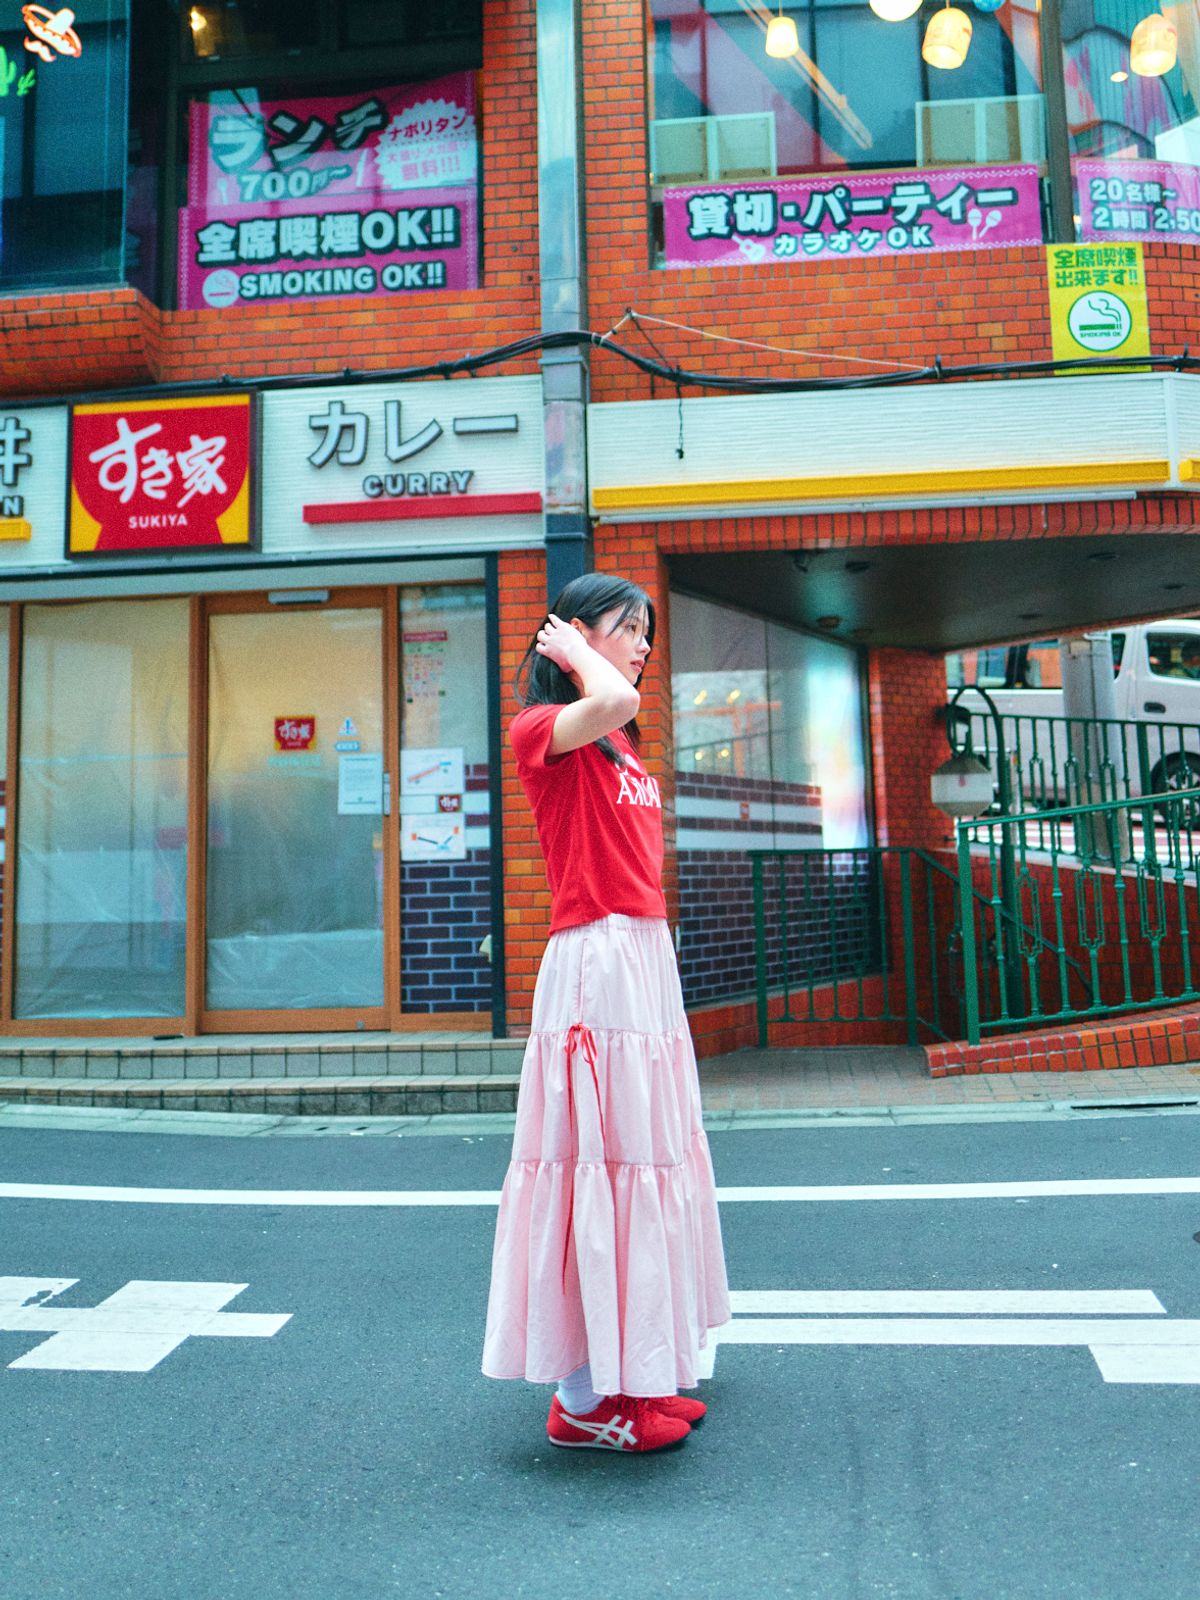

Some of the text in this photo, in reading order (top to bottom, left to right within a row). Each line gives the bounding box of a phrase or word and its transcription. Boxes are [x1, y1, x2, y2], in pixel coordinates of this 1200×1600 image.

[208, 98, 389, 173] ランチ
[387, 115, 467, 142] ナポリタン
[689, 183, 1017, 237] 貸切・パーティー
[196, 205, 458, 265] 全席喫煙OK!!
[773, 225, 934, 256] カラオケOK
[1054, 247, 1137, 269] 全席喫煙
[239, 267, 375, 299] SMOKING
[307, 400, 518, 469] カレー
[88, 417, 228, 508] すき家
[362, 470, 475, 499] CURRY
[128, 514, 188, 529] SUKIYA
